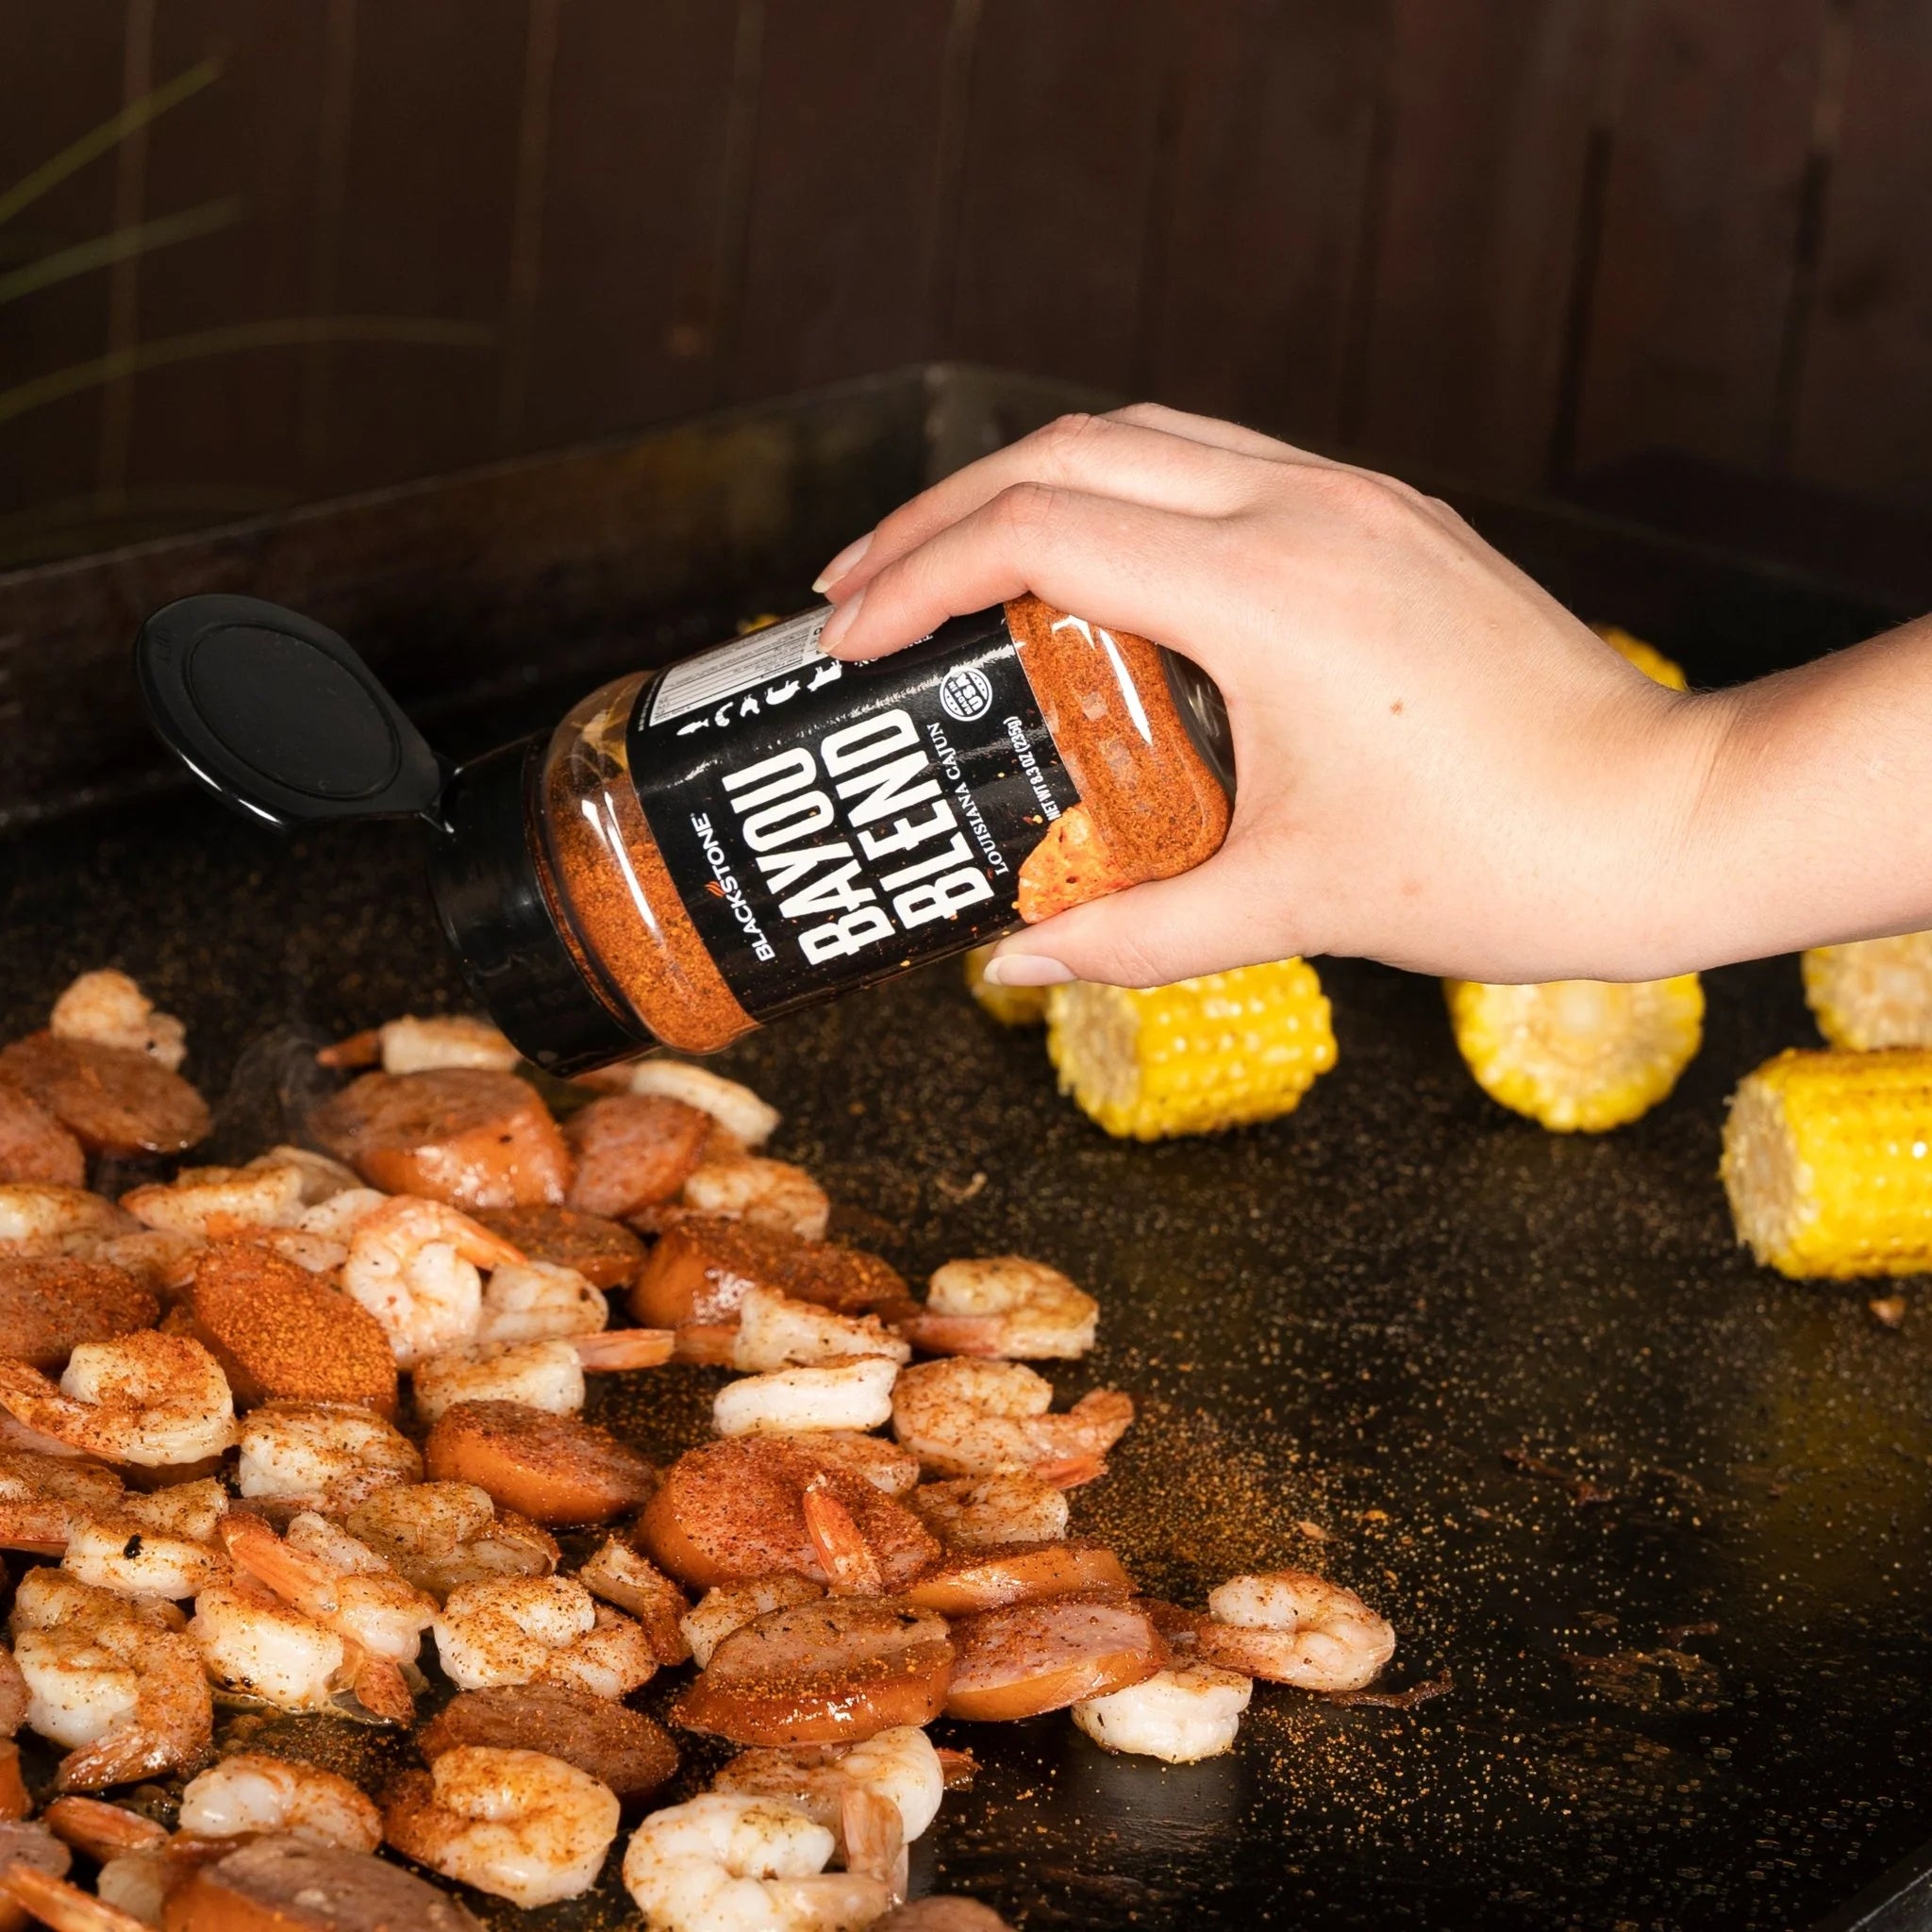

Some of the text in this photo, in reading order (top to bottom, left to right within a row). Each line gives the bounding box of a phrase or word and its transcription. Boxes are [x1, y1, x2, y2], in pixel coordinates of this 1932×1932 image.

[948, 680, 974, 715] MADE IN
[956, 673, 983, 711] USA
[821, 708, 994, 929] BLEND
[926, 722, 1008, 875] LOUISIANA CAJUN
[1003, 716, 1062, 821] NET WT 8.3 OZ (235g)
[691, 813, 775, 961] BLACKSTONE
[722, 747, 895, 965] BAYOU
